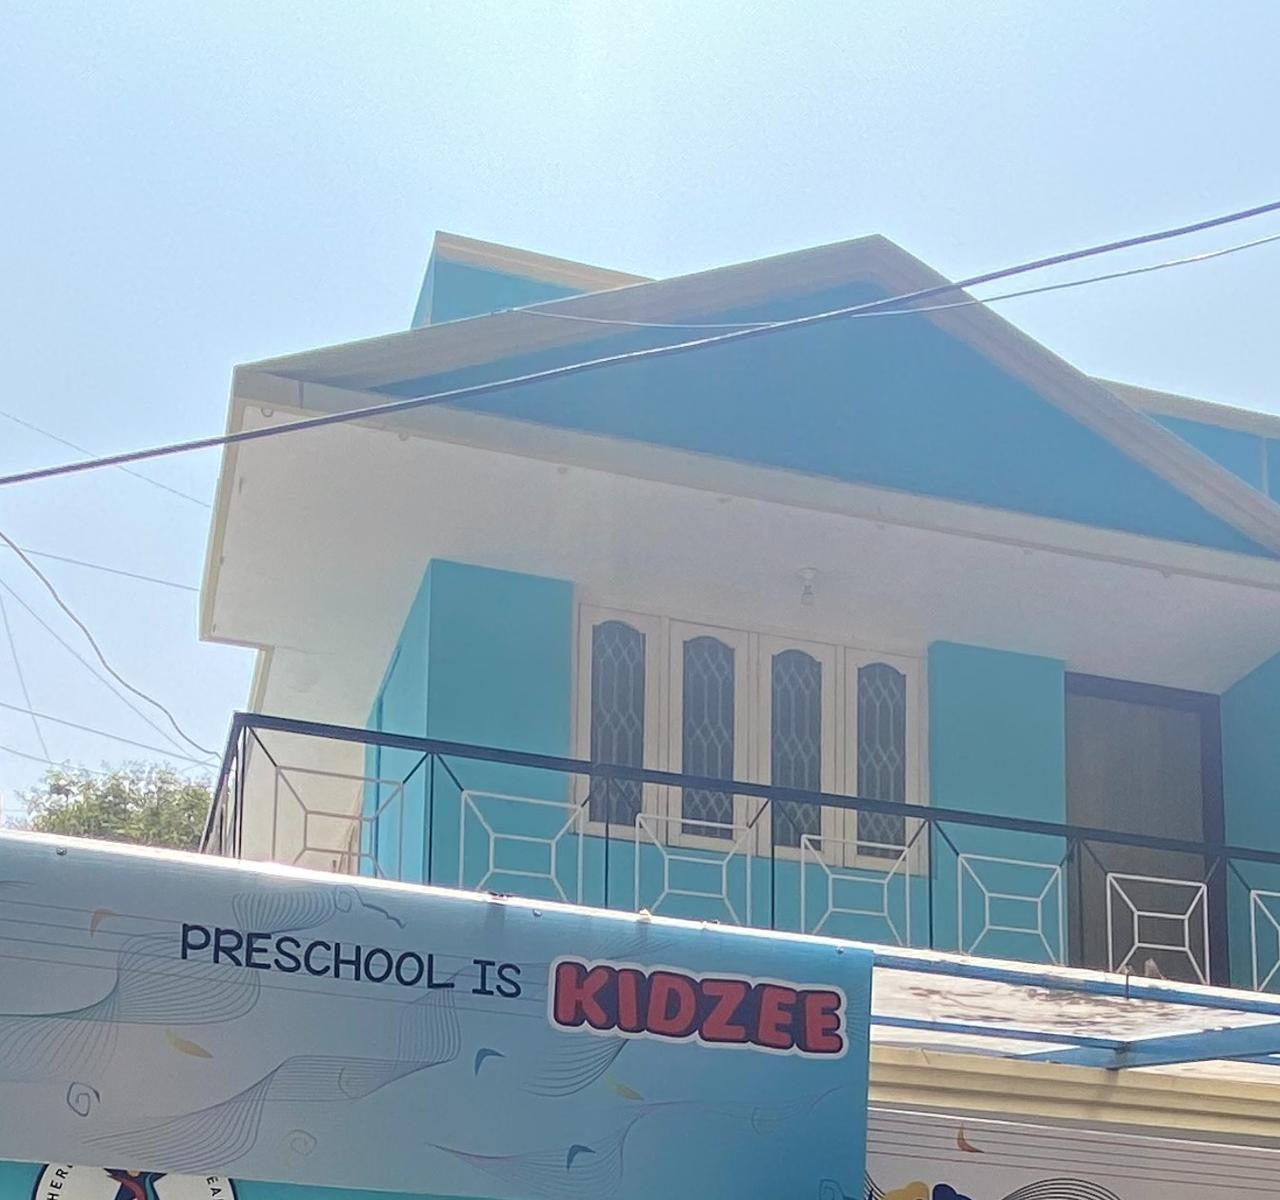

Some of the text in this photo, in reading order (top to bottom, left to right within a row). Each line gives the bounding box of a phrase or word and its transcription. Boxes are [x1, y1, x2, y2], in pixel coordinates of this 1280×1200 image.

[181, 923, 844, 1054] PRESCHOOL IS KIDZEE
